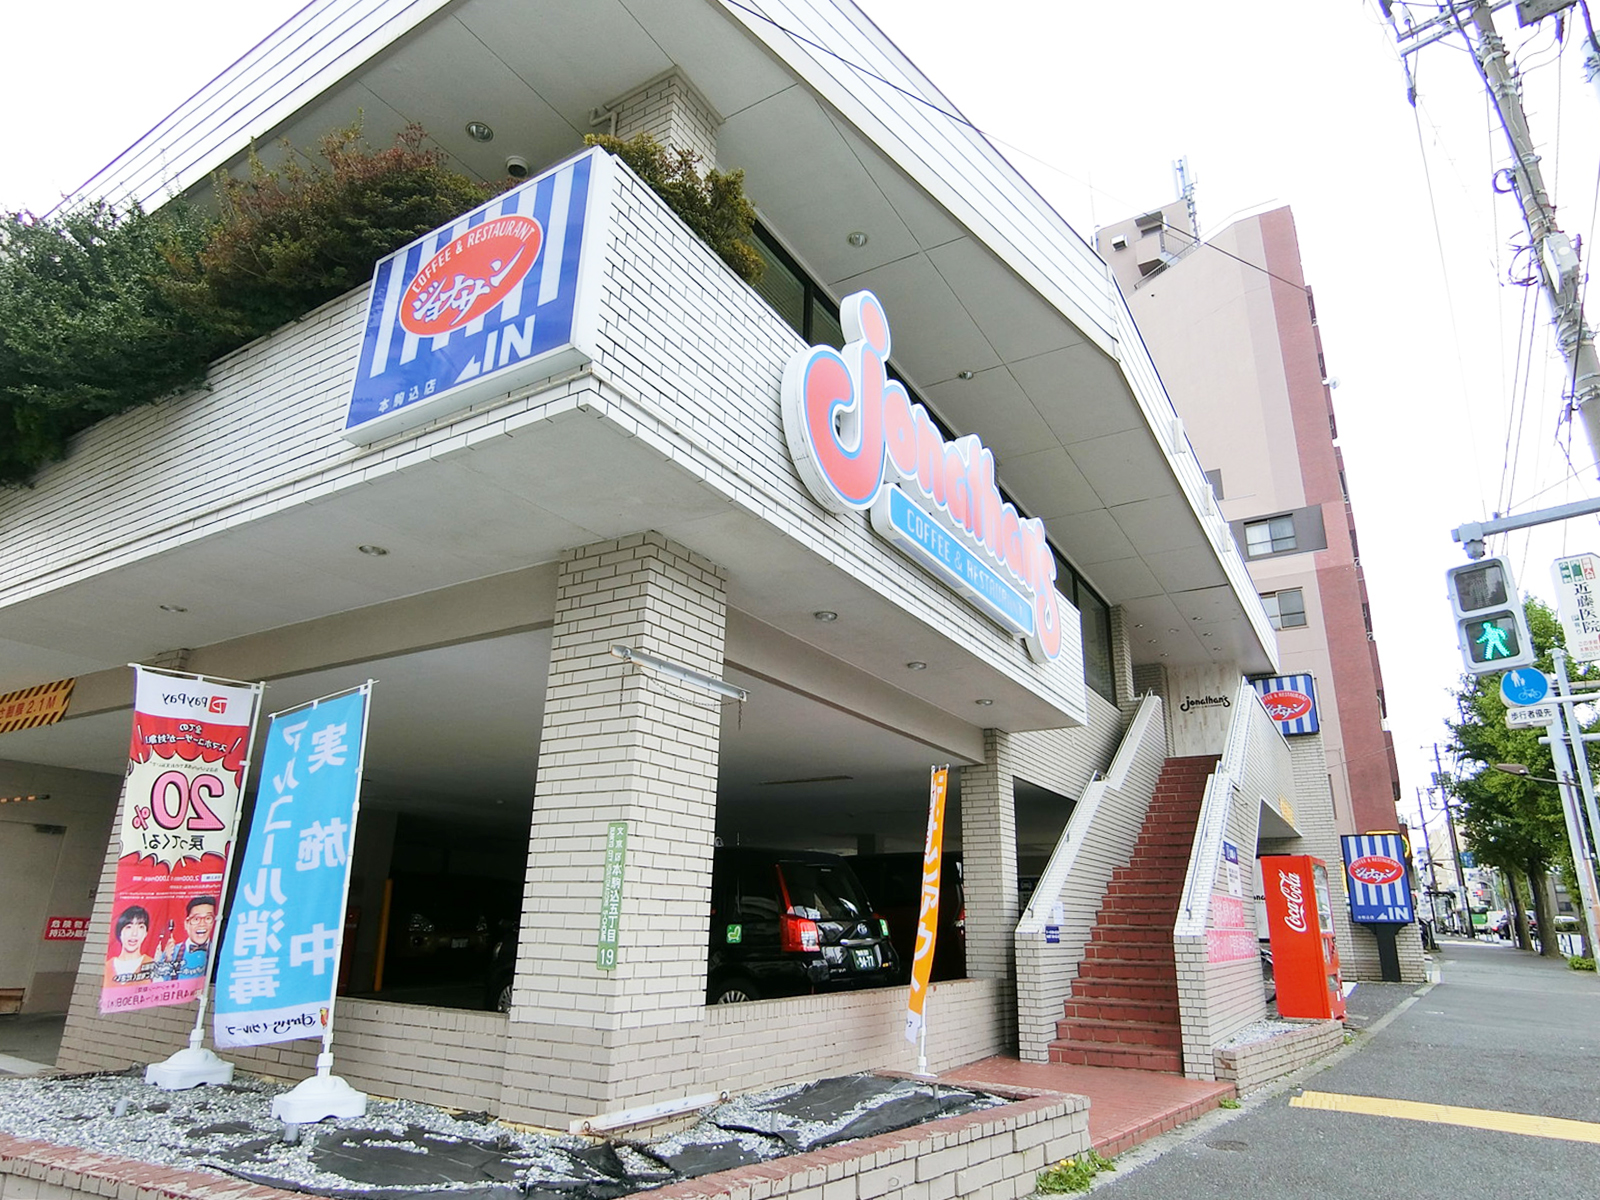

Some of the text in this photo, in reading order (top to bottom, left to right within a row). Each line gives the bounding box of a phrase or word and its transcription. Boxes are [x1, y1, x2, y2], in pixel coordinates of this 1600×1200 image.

[412, 220, 536, 293] COFFEE & RESTAURANT
[482, 314, 538, 374] IN
[378, 378, 437, 414] 本駒込店
[906, 508, 951, 564] COFFEE
[953, 550, 963, 573] &
[1510, 707, 1553, 721] 歩行者優先
[1387, 906, 1410, 920] IN
[600, 948, 614, 966] 19
